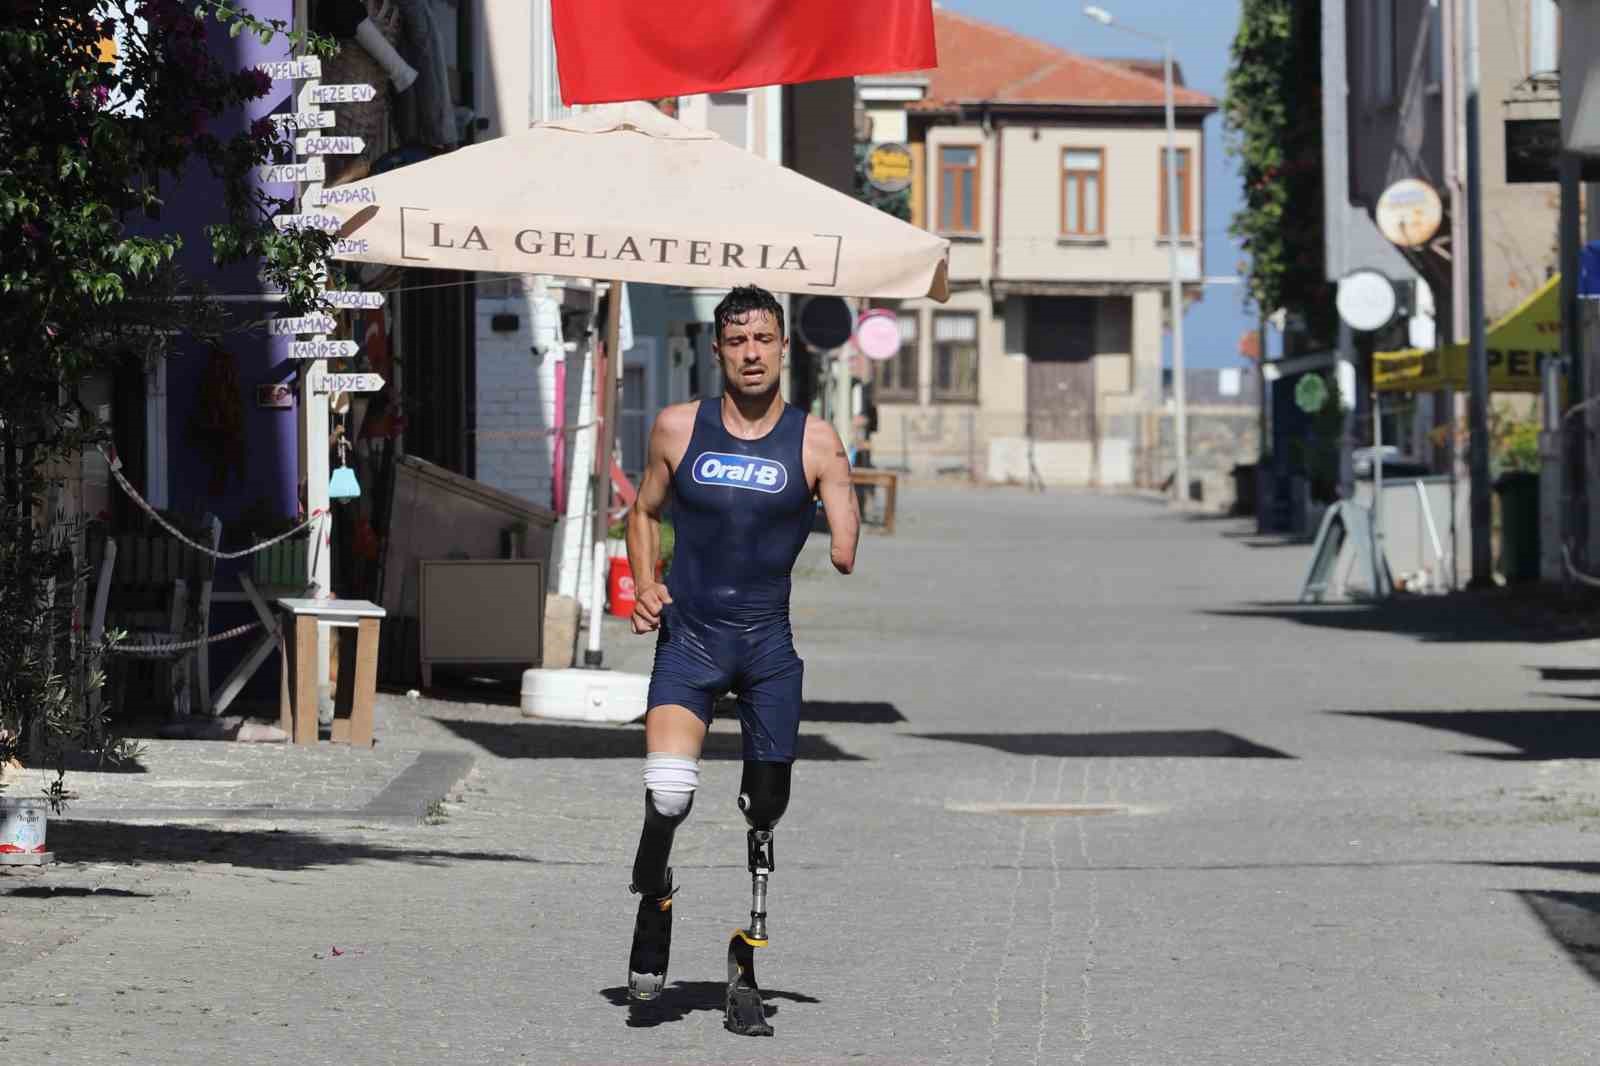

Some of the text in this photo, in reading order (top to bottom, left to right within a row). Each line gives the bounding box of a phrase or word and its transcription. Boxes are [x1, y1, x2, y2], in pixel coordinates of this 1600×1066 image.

[266, 165, 308, 182] ATOM
[430, 222, 811, 272] LA GELATERIA
[274, 317, 333, 336] KALAMAR
[701, 458, 778, 486] Oral-B
